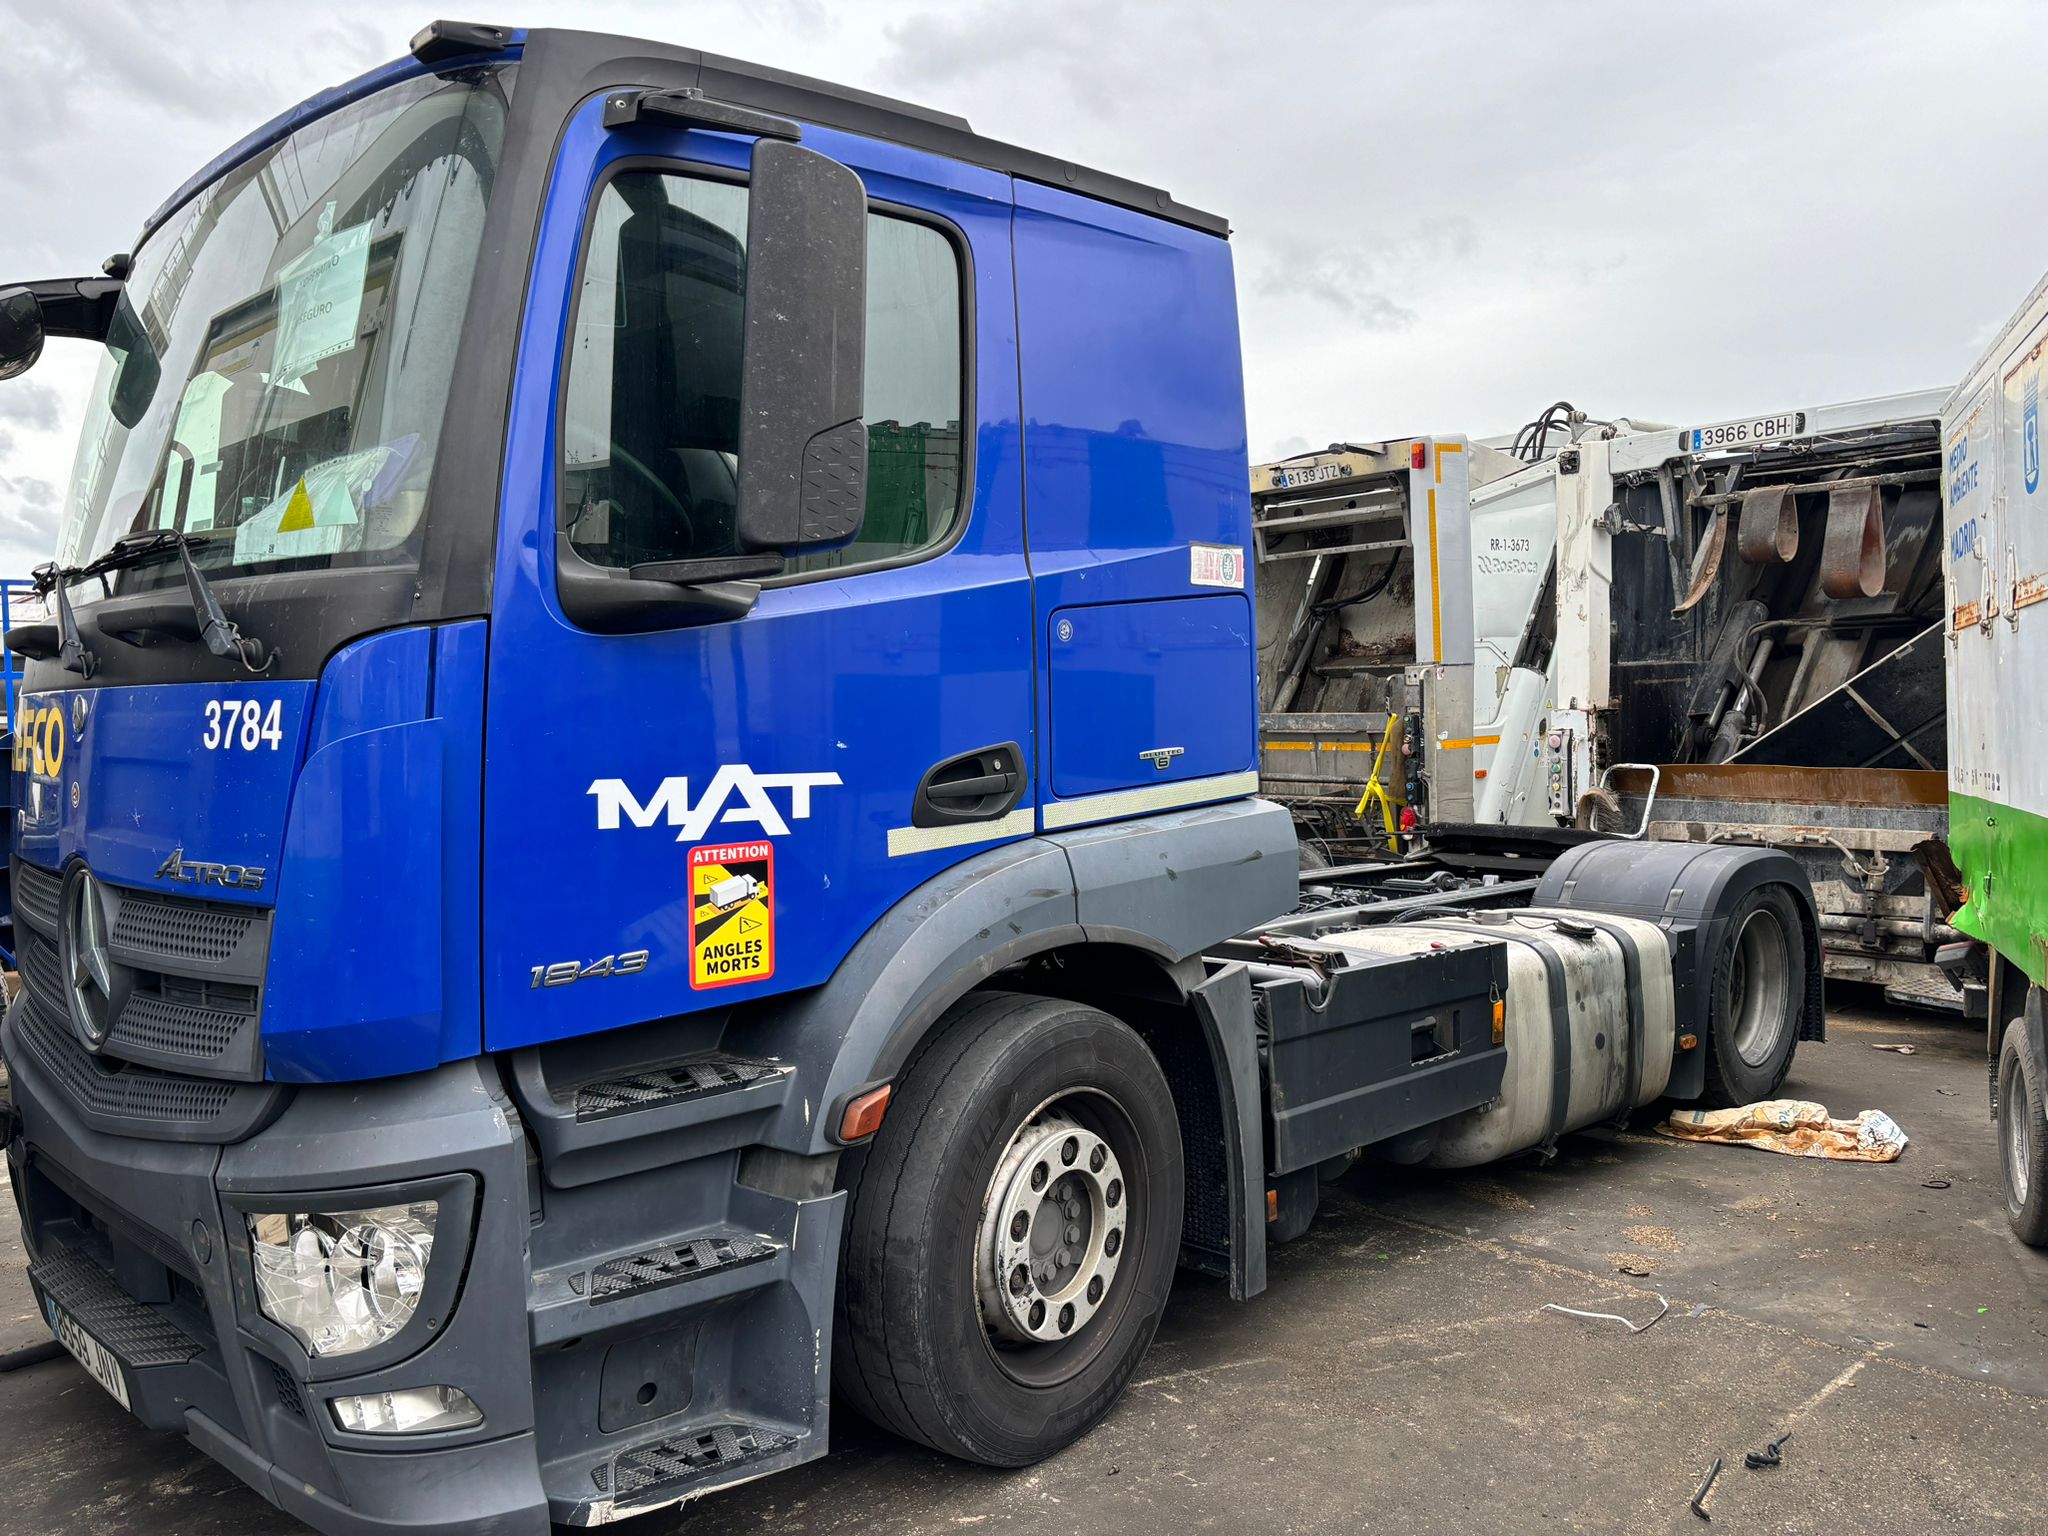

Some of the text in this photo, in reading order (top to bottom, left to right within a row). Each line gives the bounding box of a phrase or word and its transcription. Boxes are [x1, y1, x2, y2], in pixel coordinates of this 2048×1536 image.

[1704, 417, 1788, 446] 3966 CBH
[1949, 436, 1968, 474] MEDIO
[1288, 465, 1338, 485] 8139 JTZ
[1950, 460, 1979, 509] AMBIENTE
[1490, 538, 1530, 552] RR-1-3673
[1951, 518, 1977, 564] MADRID
[12, 707, 65, 778] EFCO
[203, 699, 282, 751] 3784
[1158, 757, 1169, 767] 6
[586, 764, 844, 842] MAT
[154, 847, 267, 890] ACTROS
[693, 845, 769, 863] ATTENTION
[530, 948, 650, 989] 1843
[703, 938, 763, 961] ANGLES
[706, 955, 760, 976] MORTS
[54, 1302, 122, 1398] 8559 JNV
